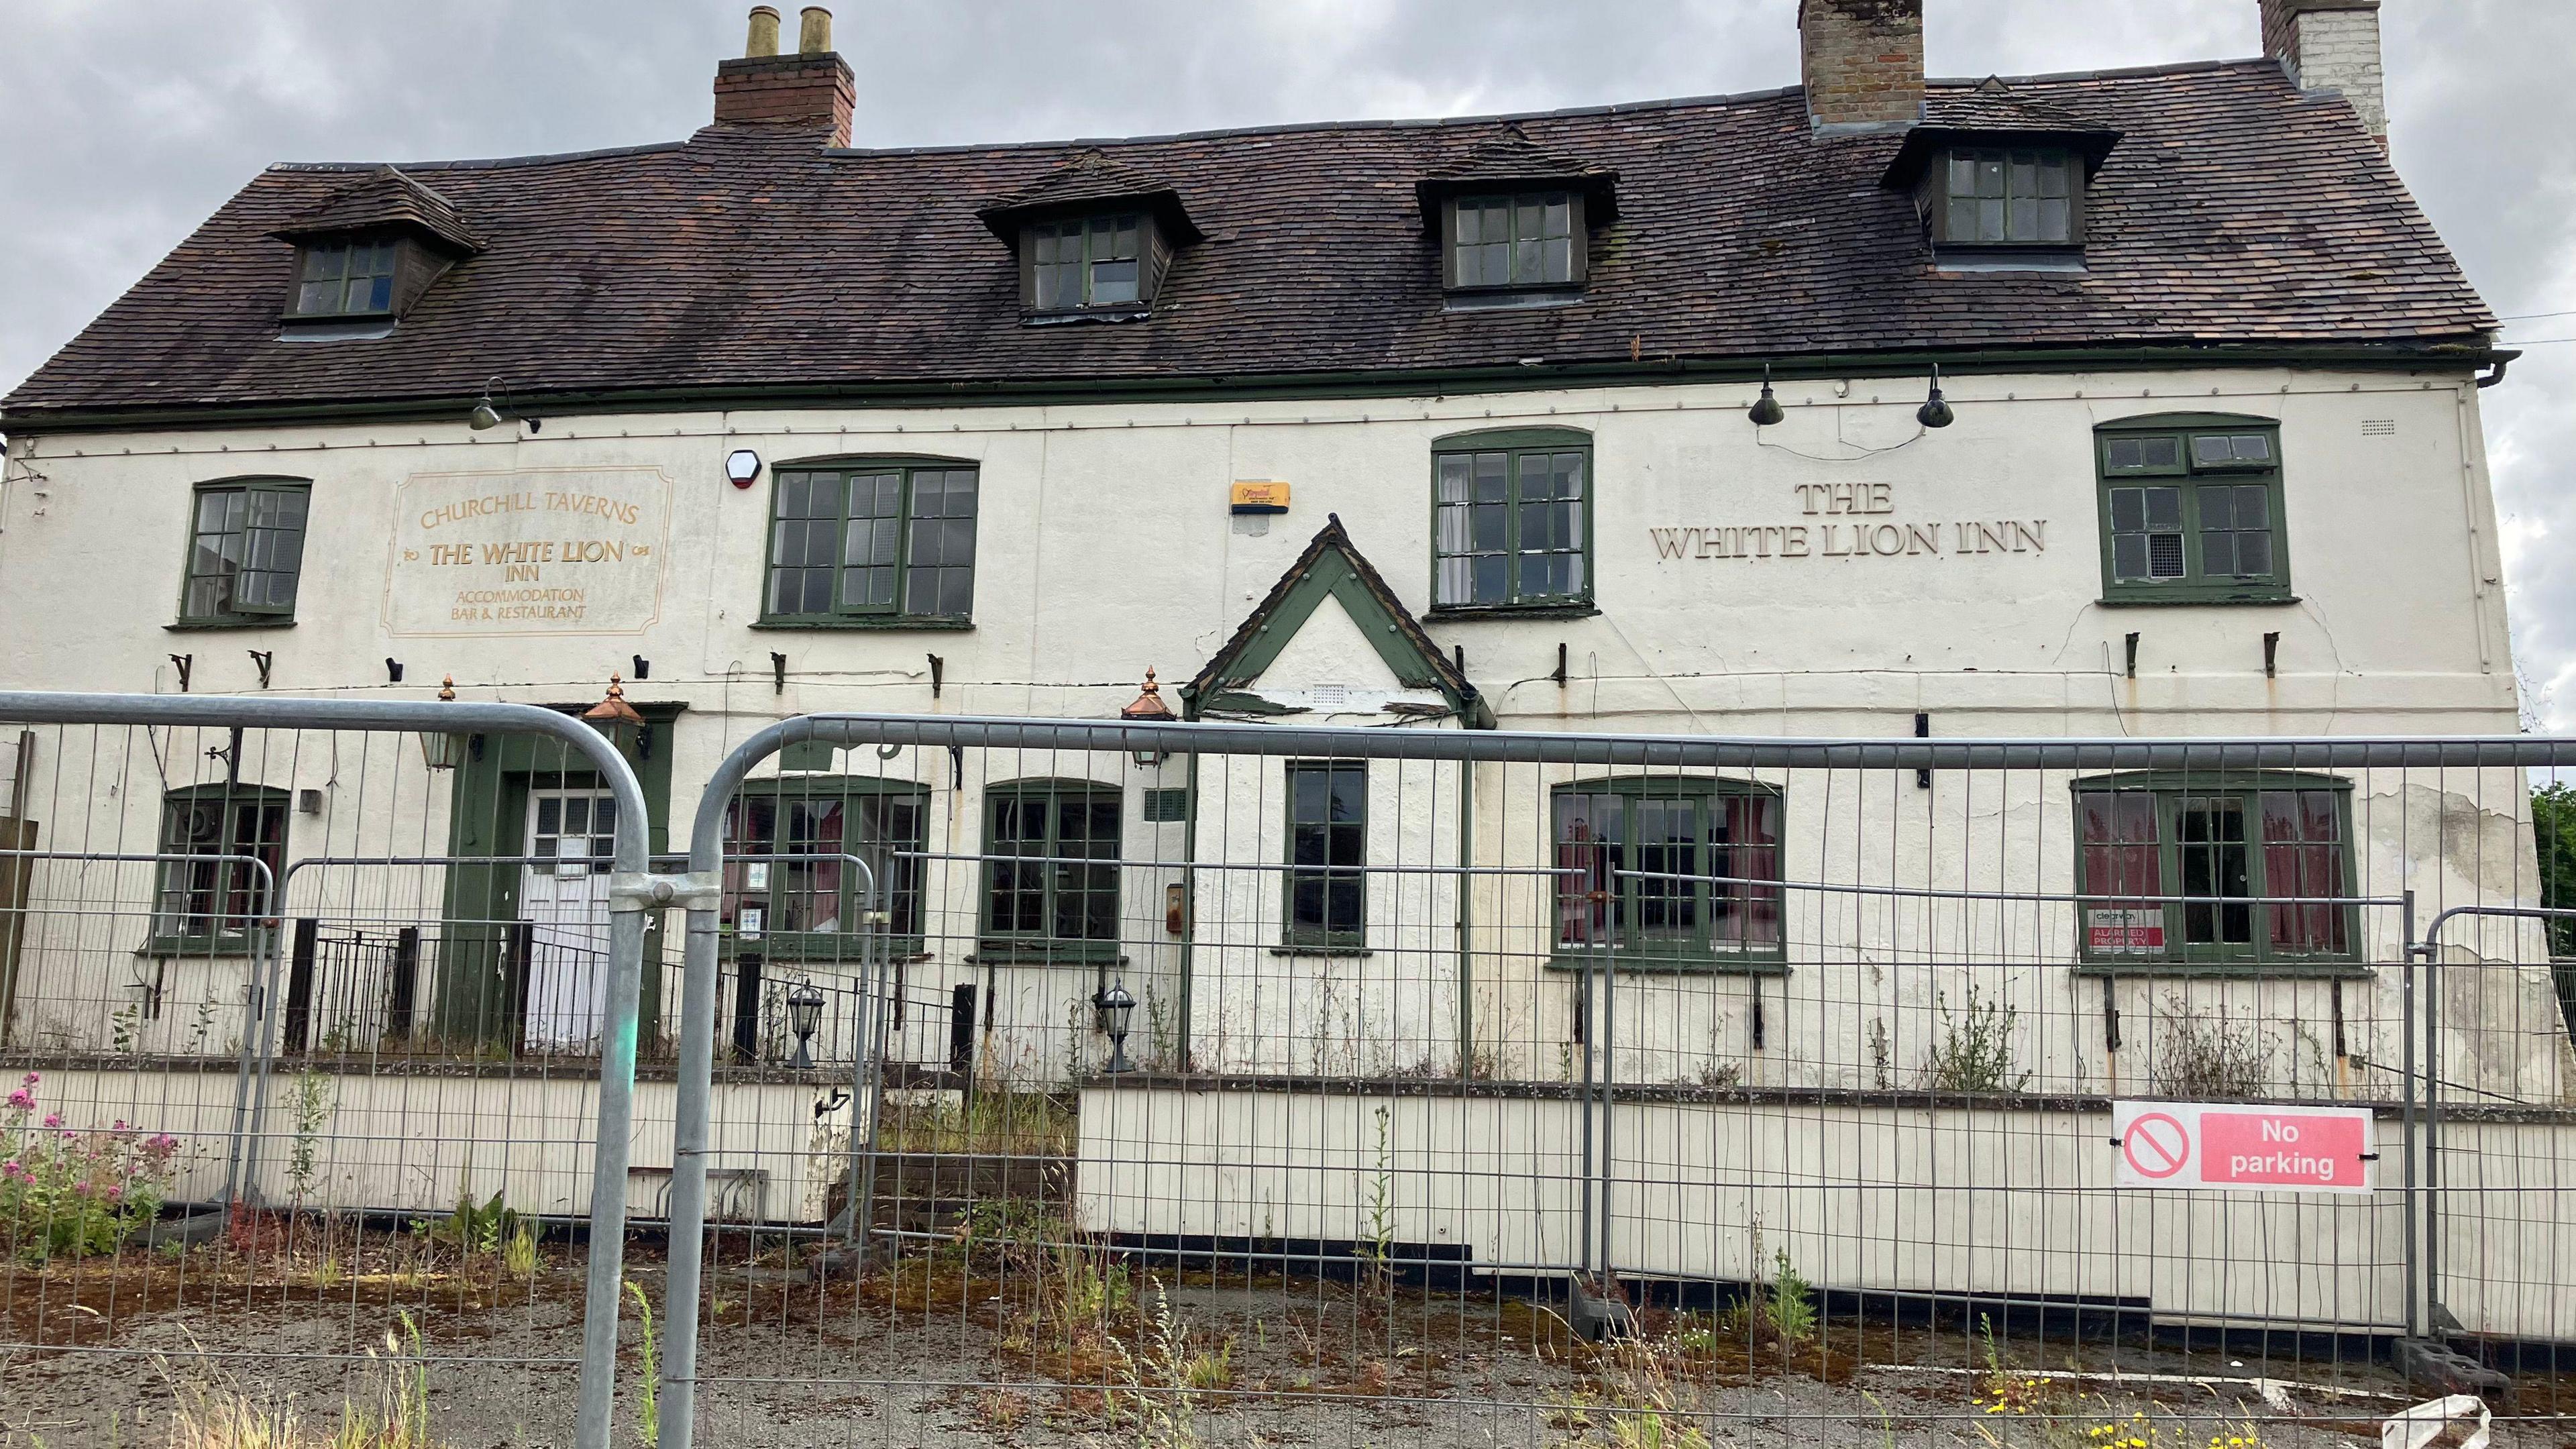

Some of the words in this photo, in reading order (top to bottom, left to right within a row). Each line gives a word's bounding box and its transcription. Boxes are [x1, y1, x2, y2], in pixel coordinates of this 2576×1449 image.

[420, 492, 537, 530] CHURCHILL
[545, 492, 640, 526] TAVERNS
[1795, 482, 1894, 515] THE
[1650, 525, 1811, 559] WHITE
[1821, 523, 1941, 556] LION
[1955, 519, 2048, 554] INN
[429, 543, 473, 566] THE
[482, 541, 553, 565] WHITE
[561, 540, 625, 563] LION
[505, 565, 539, 582] INN
[455, 588, 585, 604] ACCOMMODATION
[451, 607, 478, 621] BAR
[482, 607, 493, 620] &
[498, 605, 587, 620] RESTAURANT
[2261, 1120, 2299, 1142] No
[2231, 1152, 2334, 1181] parking
